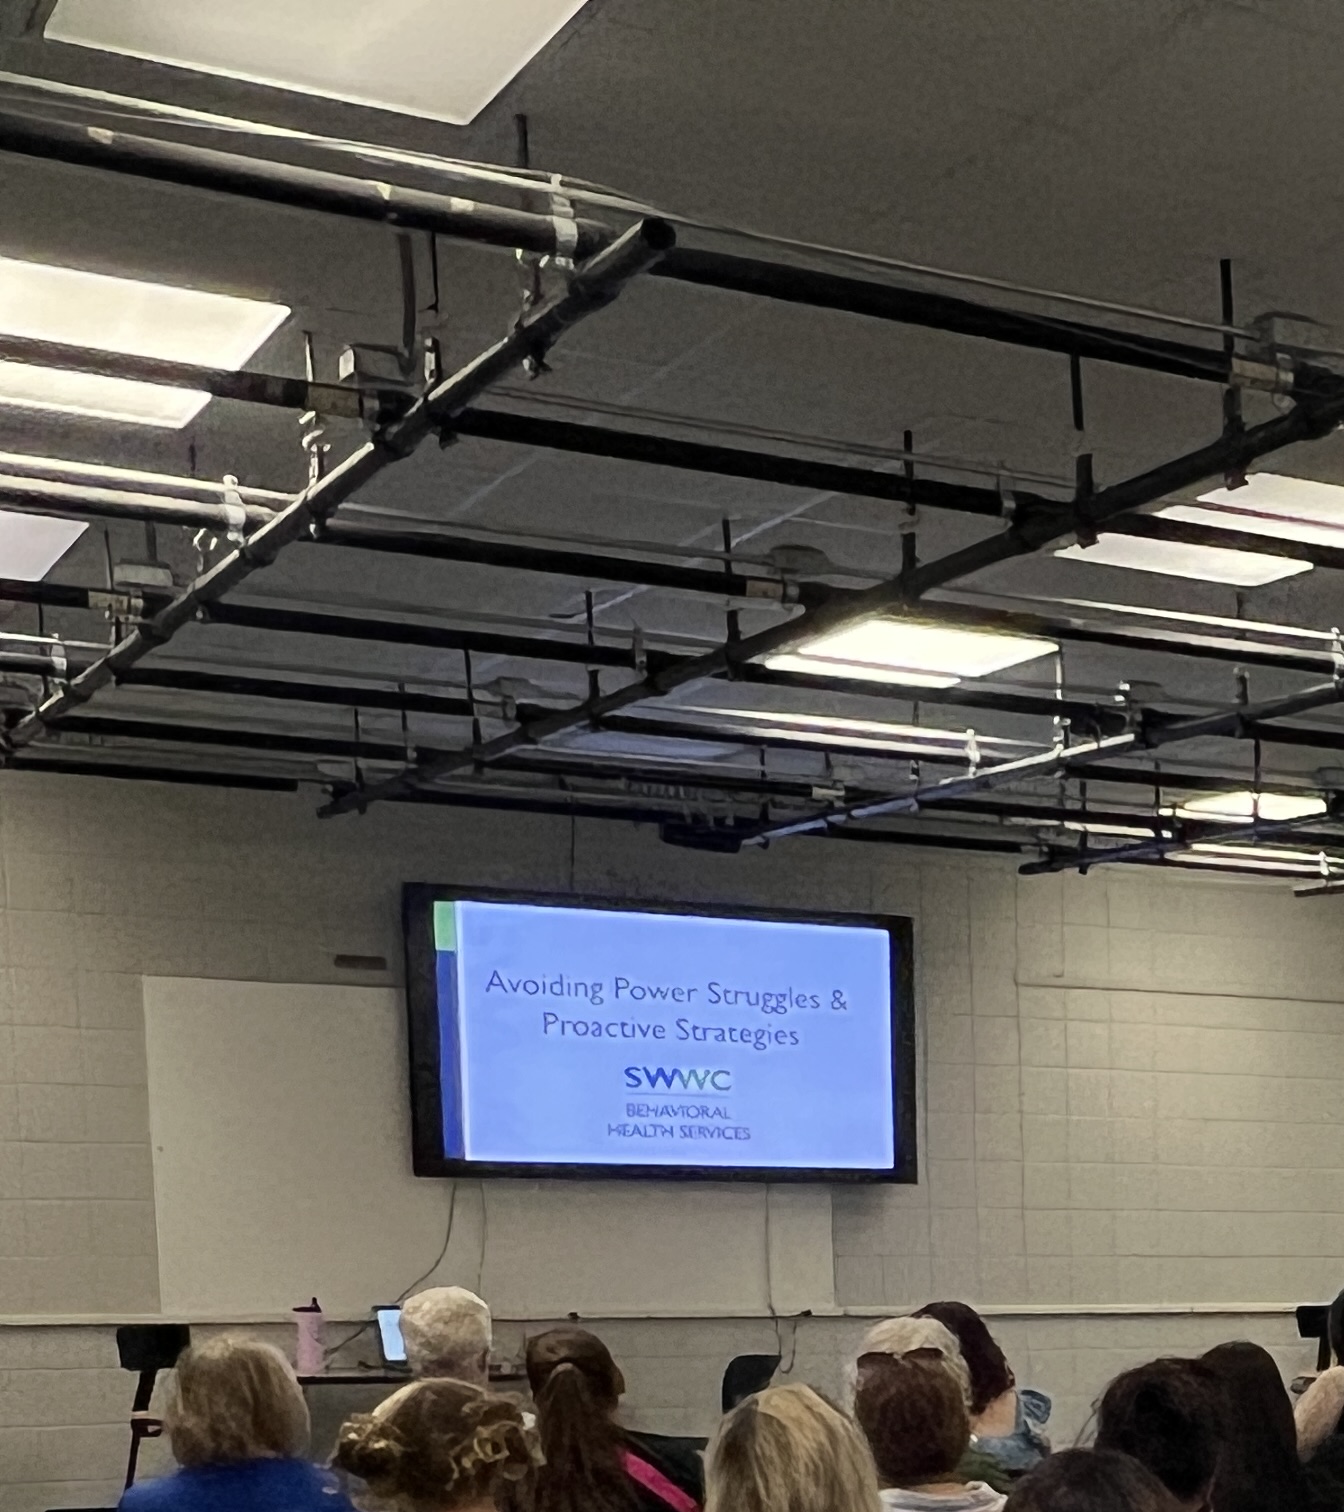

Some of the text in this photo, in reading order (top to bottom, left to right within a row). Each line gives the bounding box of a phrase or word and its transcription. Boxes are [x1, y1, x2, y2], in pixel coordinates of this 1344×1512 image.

[485, 970, 848, 1015] Avoiding Power Struggles &
[543, 1012, 801, 1050] Proactive Strategies
[623, 1066, 732, 1092] SWWC
[625, 1103, 732, 1121] BEHAVIORAL
[607, 1123, 752, 1142] HEALTH SERVICES
